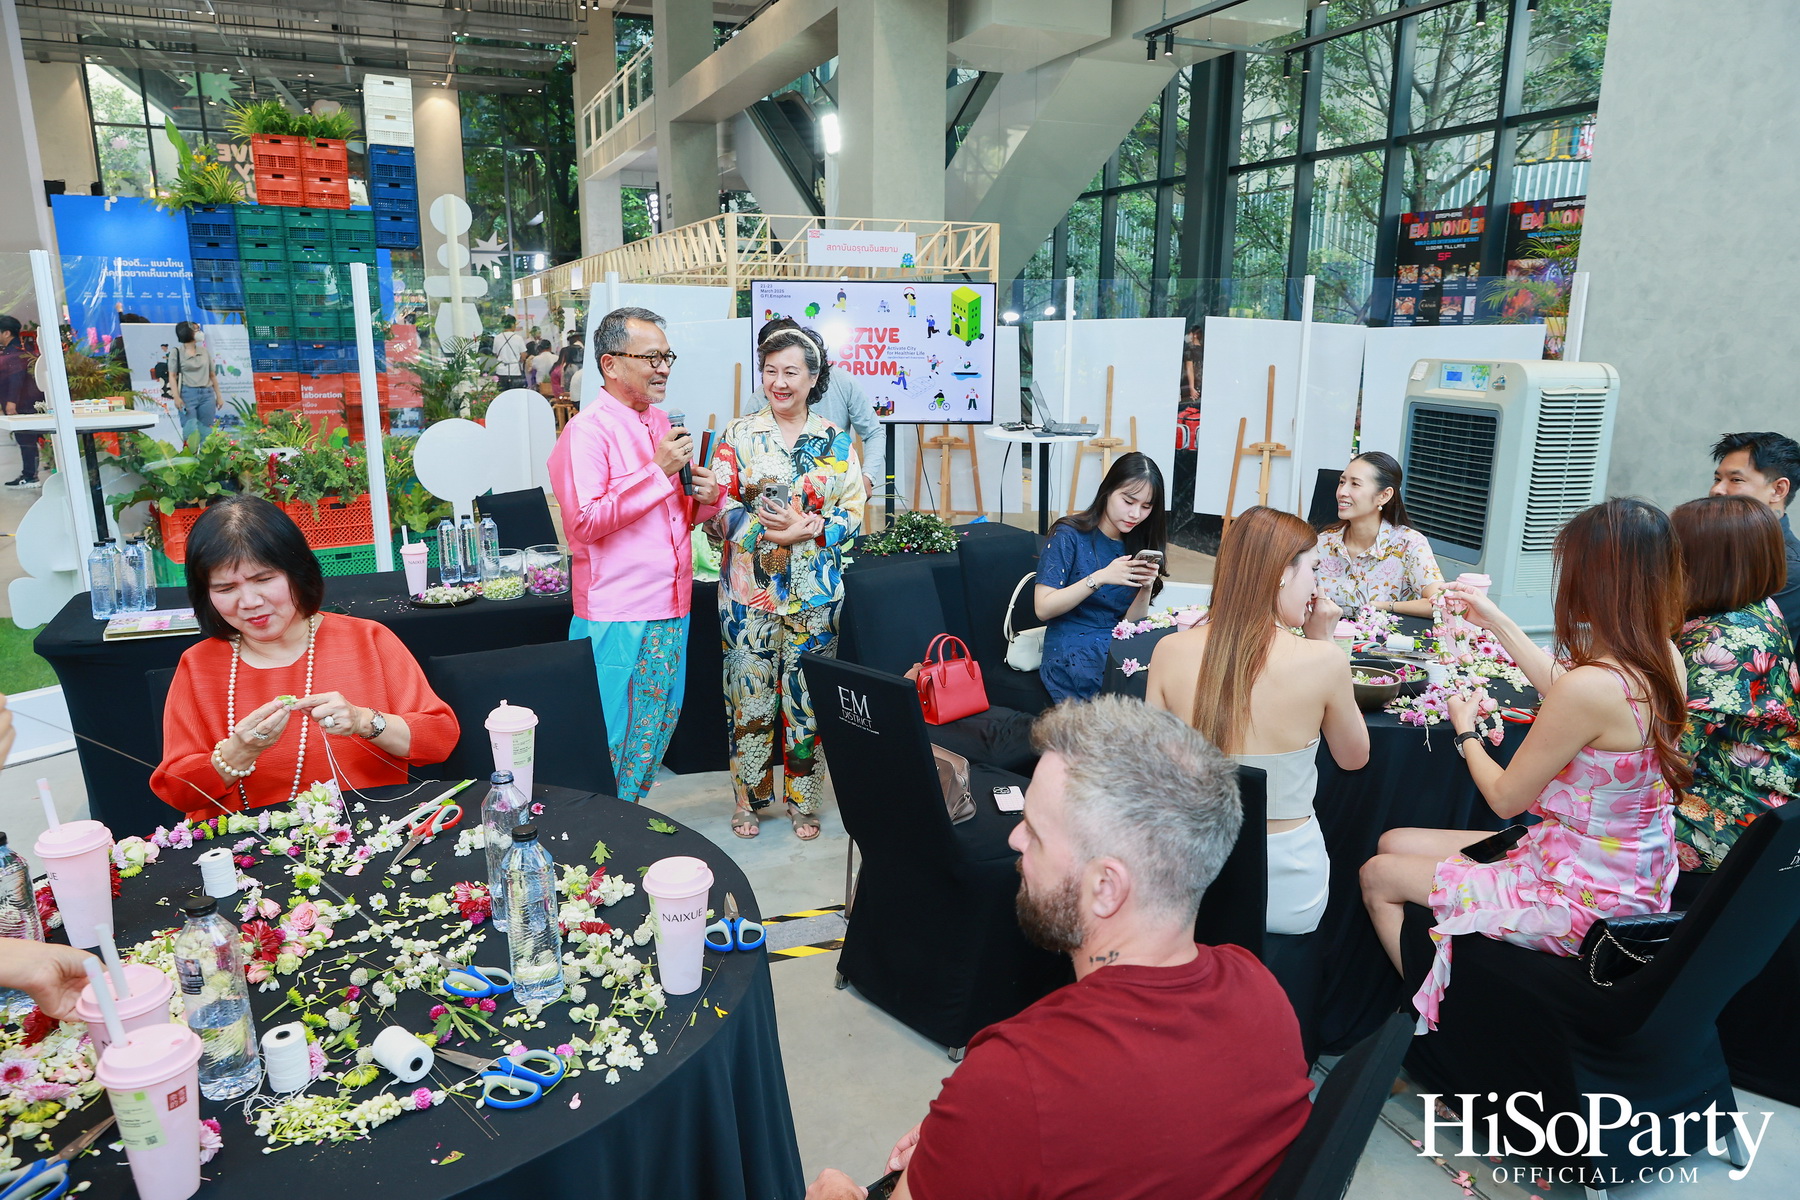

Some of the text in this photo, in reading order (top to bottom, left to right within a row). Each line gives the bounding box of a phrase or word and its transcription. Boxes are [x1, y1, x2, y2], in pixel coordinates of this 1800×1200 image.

[1520, 212, 1546, 230] EM
[1409, 222, 1429, 239] EM
[1437, 252, 1452, 261] SF
[839, 344, 886, 360] CITY
[828, 360, 897, 376] ORUM
[838, 685, 871, 719] EM
[842, 709, 872, 728] DISTRICT
[662, 907, 703, 922] NAIXUE
